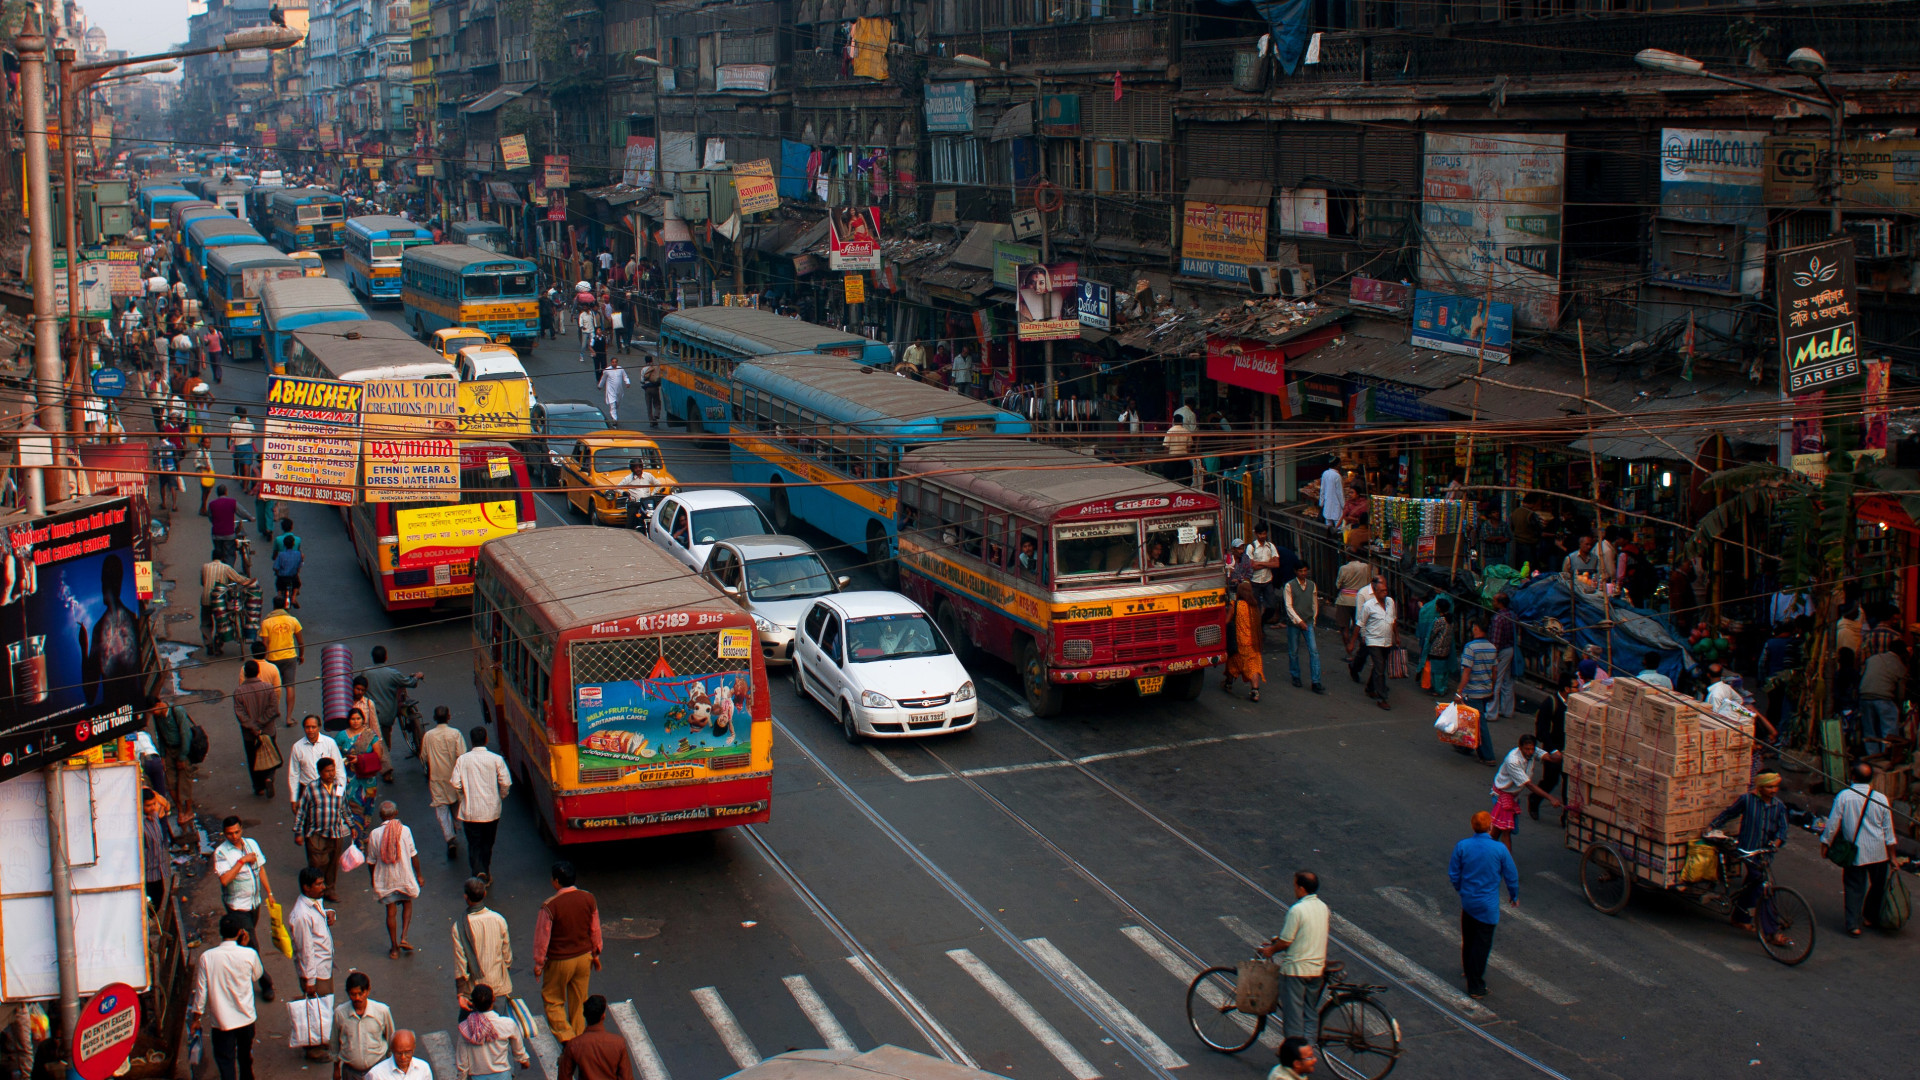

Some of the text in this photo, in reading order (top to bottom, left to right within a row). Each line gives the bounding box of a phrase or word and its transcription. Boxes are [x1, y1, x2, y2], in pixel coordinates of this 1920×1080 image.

[1470, 138, 1498, 149] Paulson
[1688, 138, 1765, 169] AUTOCOLO
[841, 243, 871, 254] Ashok
[1523, 249, 1547, 270] BLACK
[1183, 259, 1214, 276] NANDY
[1083, 315, 1107, 327] STORES
[1793, 327, 1854, 369] Mala
[1233, 353, 1278, 375] just baked
[1793, 361, 1857, 388] SAREES
[269, 379, 363, 412] ABHISHEK
[366, 382, 457, 398] ROYAL TOUCH
[366, 401, 458, 415] CREATIONS (P) Ltd.
[458, 407, 519, 433] ROWN
[286, 423, 340, 435] A HOUSE OF
[268, 442, 295, 452] DHOTI
[370, 439, 454, 465] Raymond
[265, 453, 355, 469] SUIT & PARTY DRESS
[275, 472, 289, 480] 3rd
[287, 464, 320, 475] Burtolla
[321, 468, 346, 478] Street
[373, 465, 451, 474] ETHNIC WEAR &
[367, 475, 457, 485] DRESS MATERIALS
[263, 482, 271, 493] Ph
[275, 484, 292, 496] 98301
[293, 486, 311, 499] 84432
[315, 488, 333, 500] 98301
[333, 491, 352, 502] 33456
[1172, 495, 1195, 508] Bus
[50, 521, 75, 540] lungs
[75, 518, 89, 533] are
[89, 512, 104, 529] full
[104, 509, 113, 526] of
[33, 534, 112, 566] that causes cancer
[697, 613, 724, 625] Bus
[1096, 668, 1131, 680] SPEED
[117, 704, 133, 716] Kills
[92, 712, 133, 735] QUIT TODAY
[626, 714, 647, 722] CAKES
[715, 804, 753, 816] Please
[83, 1009, 132, 1041] NO ENTRY EXCEPT
[82, 1036, 100, 1051] BUSES
